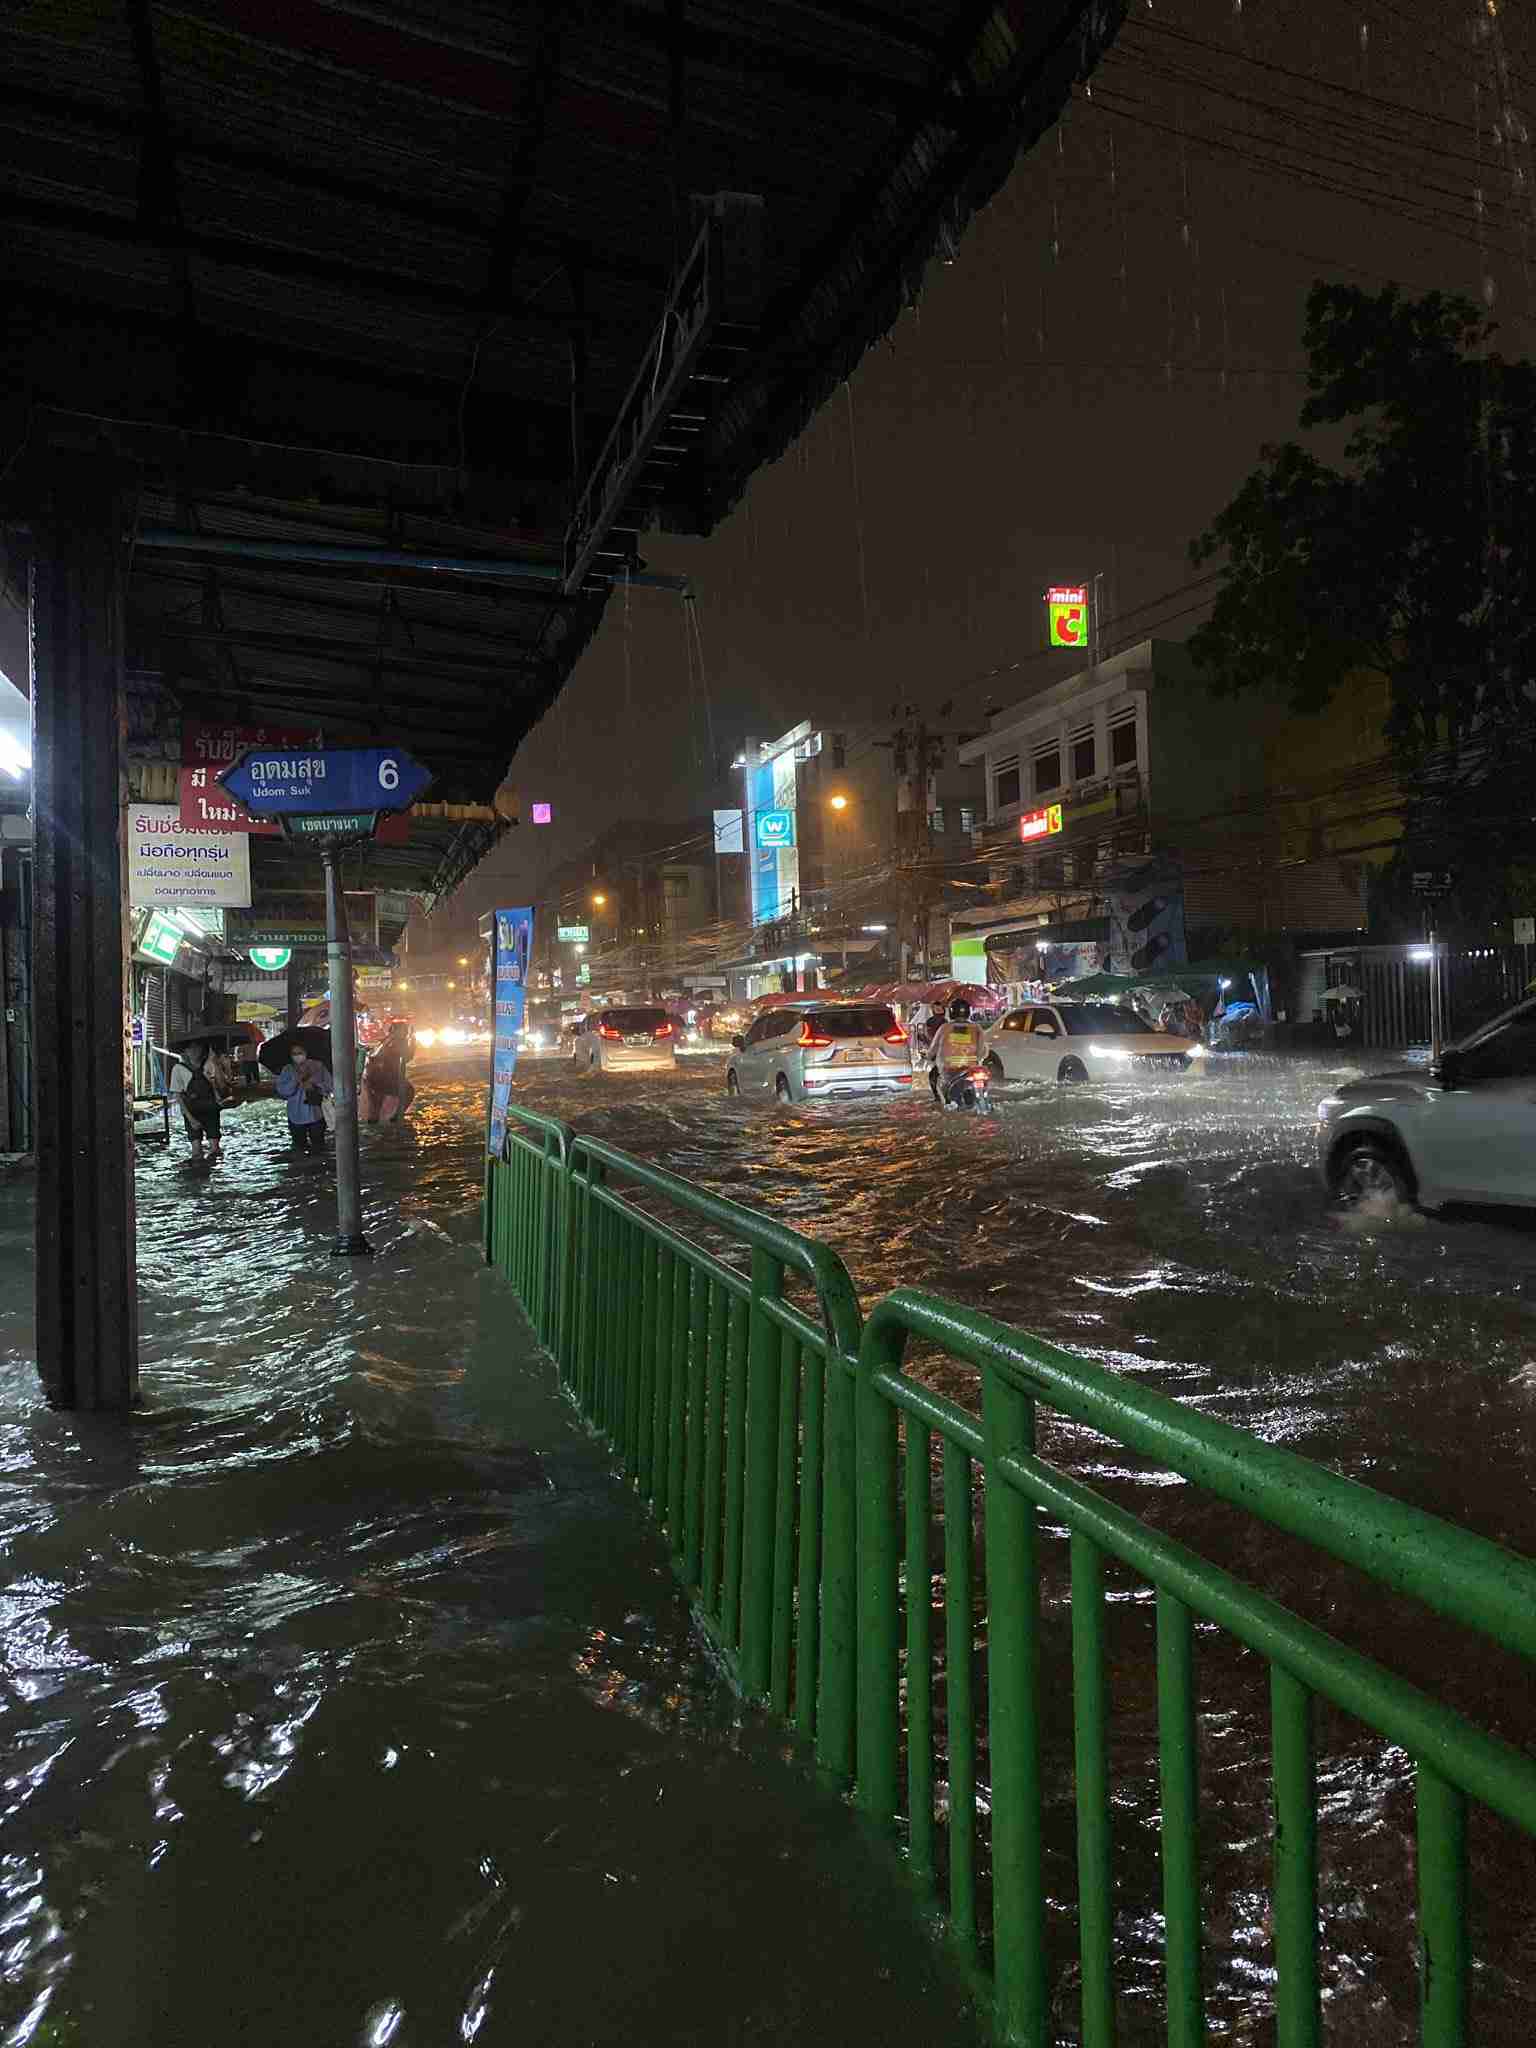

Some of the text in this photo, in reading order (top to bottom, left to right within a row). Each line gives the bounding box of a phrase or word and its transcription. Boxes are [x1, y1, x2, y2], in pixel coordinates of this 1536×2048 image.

[251, 758, 326, 786] อุดมสุข
[378, 759, 399, 790] 6
[252, 784, 311, 798] Udom Suk
[301, 817, 359, 833] เขตบางนา
